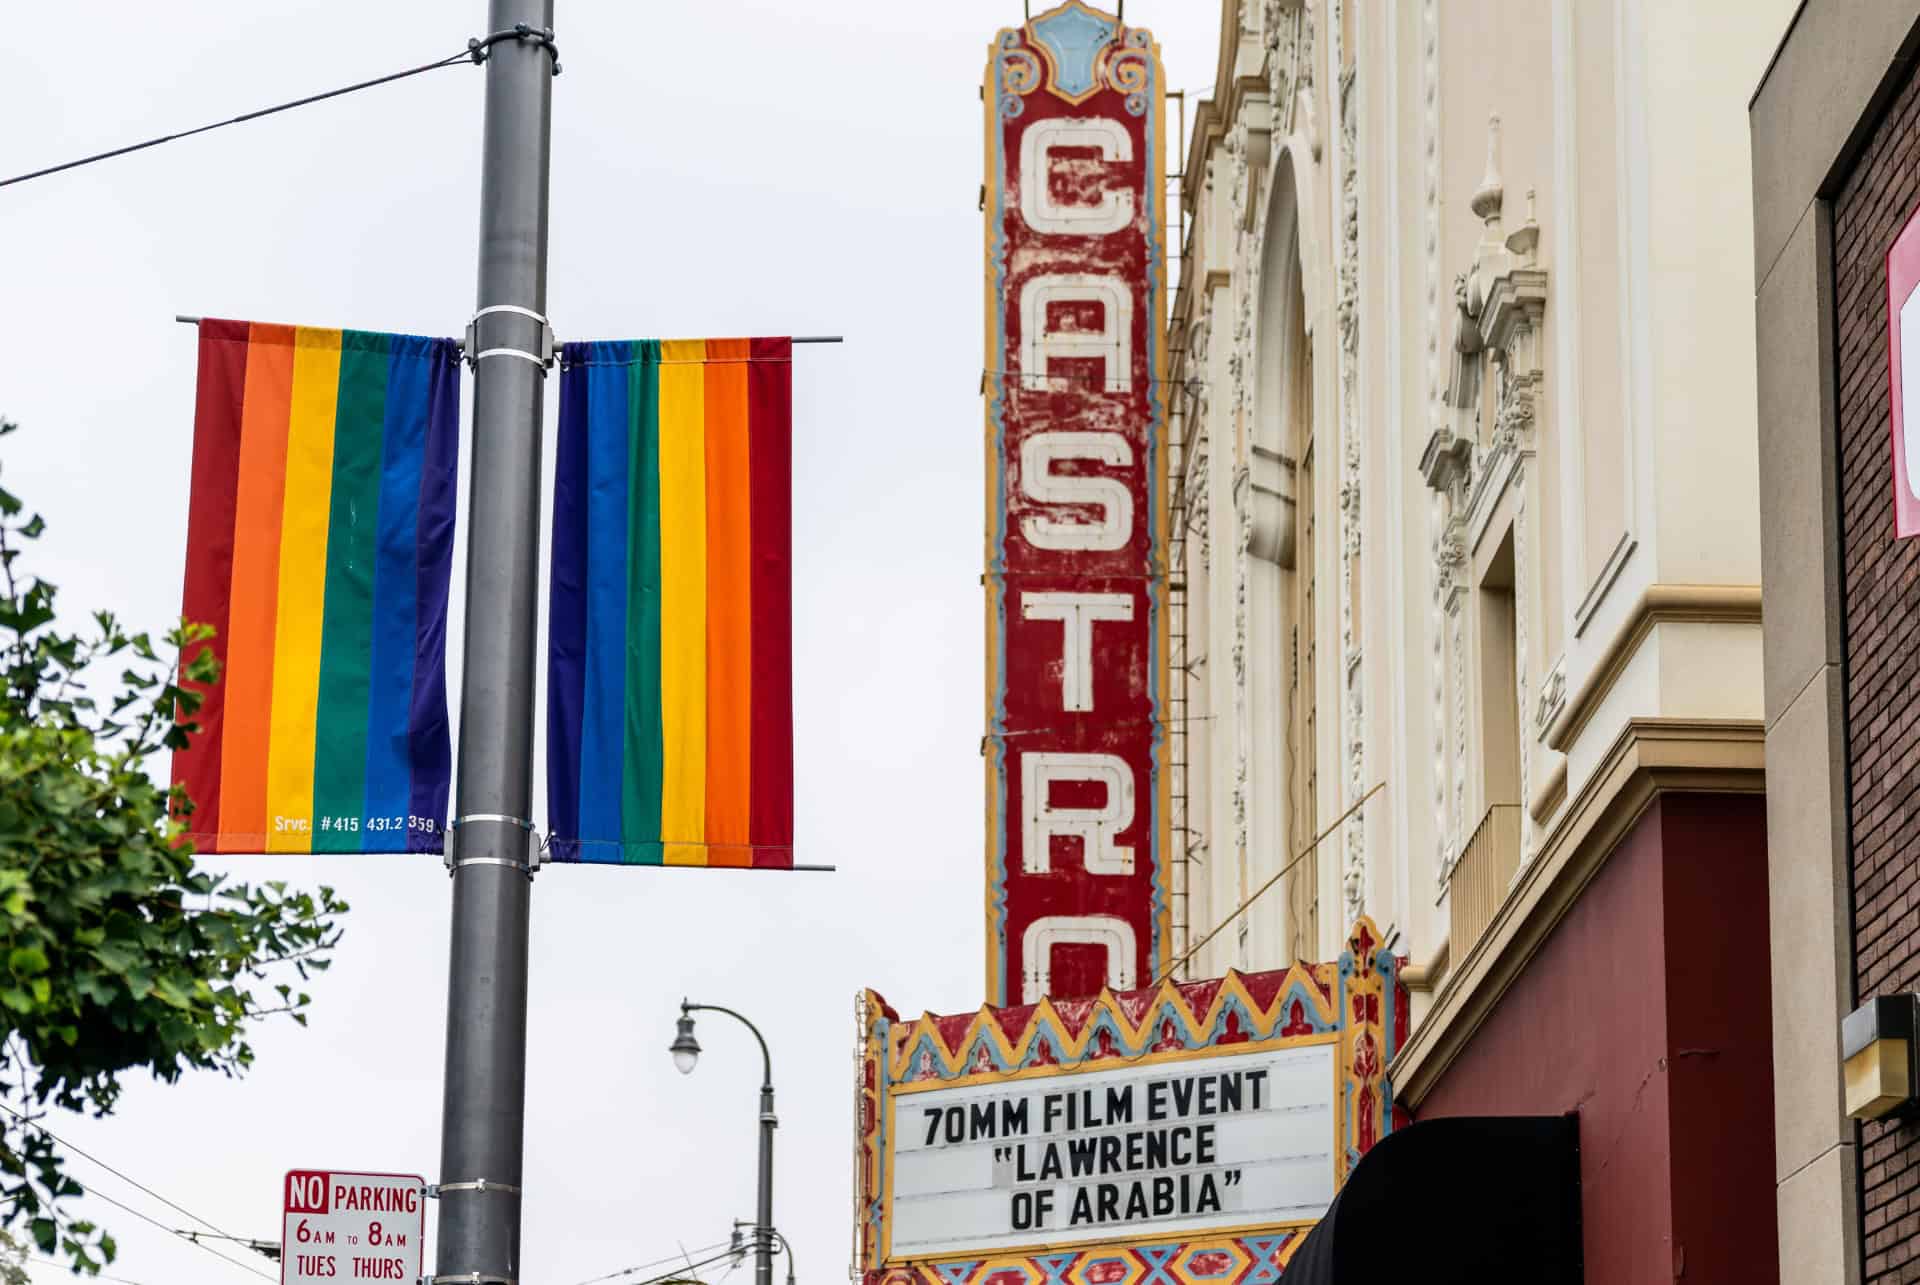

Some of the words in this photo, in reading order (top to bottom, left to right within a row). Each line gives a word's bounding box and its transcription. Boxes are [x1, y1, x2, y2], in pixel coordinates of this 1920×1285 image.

[1019, 117, 1137, 1006] CASTRO
[924, 1097, 1028, 1147] 70MM
[1043, 1084, 1134, 1133] FILM
[1147, 1069, 1268, 1122] EVENT
[994, 1123, 1217, 1182] "LAWRENCE
[289, 1175, 325, 1210] NO
[334, 1185, 417, 1213] PARKING
[1011, 1188, 1054, 1231] OF
[1069, 1169, 1242, 1226] ARABIA"
[296, 1255, 336, 1277] TUES
[352, 1256, 404, 1280] THURS
[347, 1235, 358, 1246] TO
